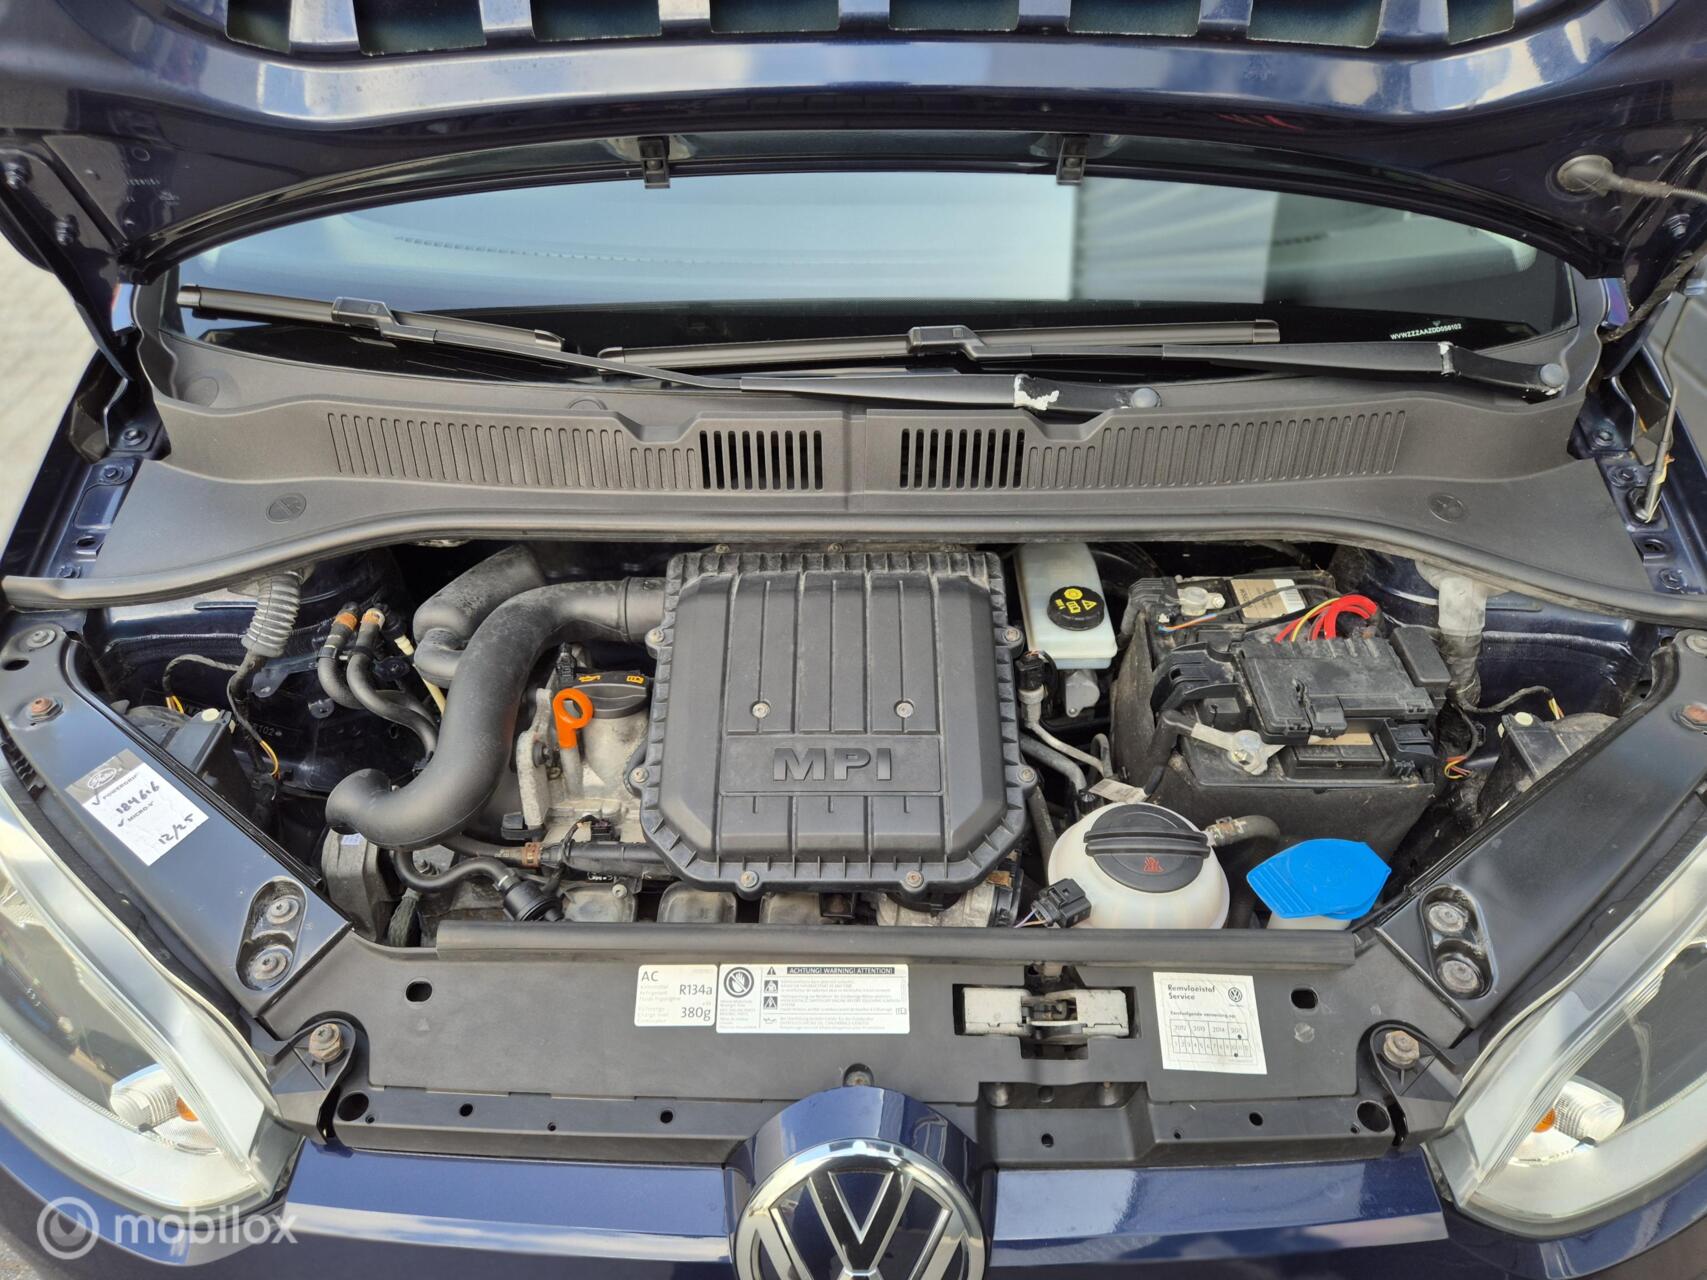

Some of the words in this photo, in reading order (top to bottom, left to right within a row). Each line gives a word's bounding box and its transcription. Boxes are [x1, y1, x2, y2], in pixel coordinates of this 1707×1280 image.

[773, 748, 892, 781] MPI
[158, 813, 194, 844] 12/25
[641, 970, 659, 982] AC
[824, 967, 855, 975] WARNING!
[857, 967, 893, 975] ATTENTION!
[679, 983, 713, 996] R134a
[1168, 993, 1196, 1001] Service
[681, 1006, 711, 1022] 380g
